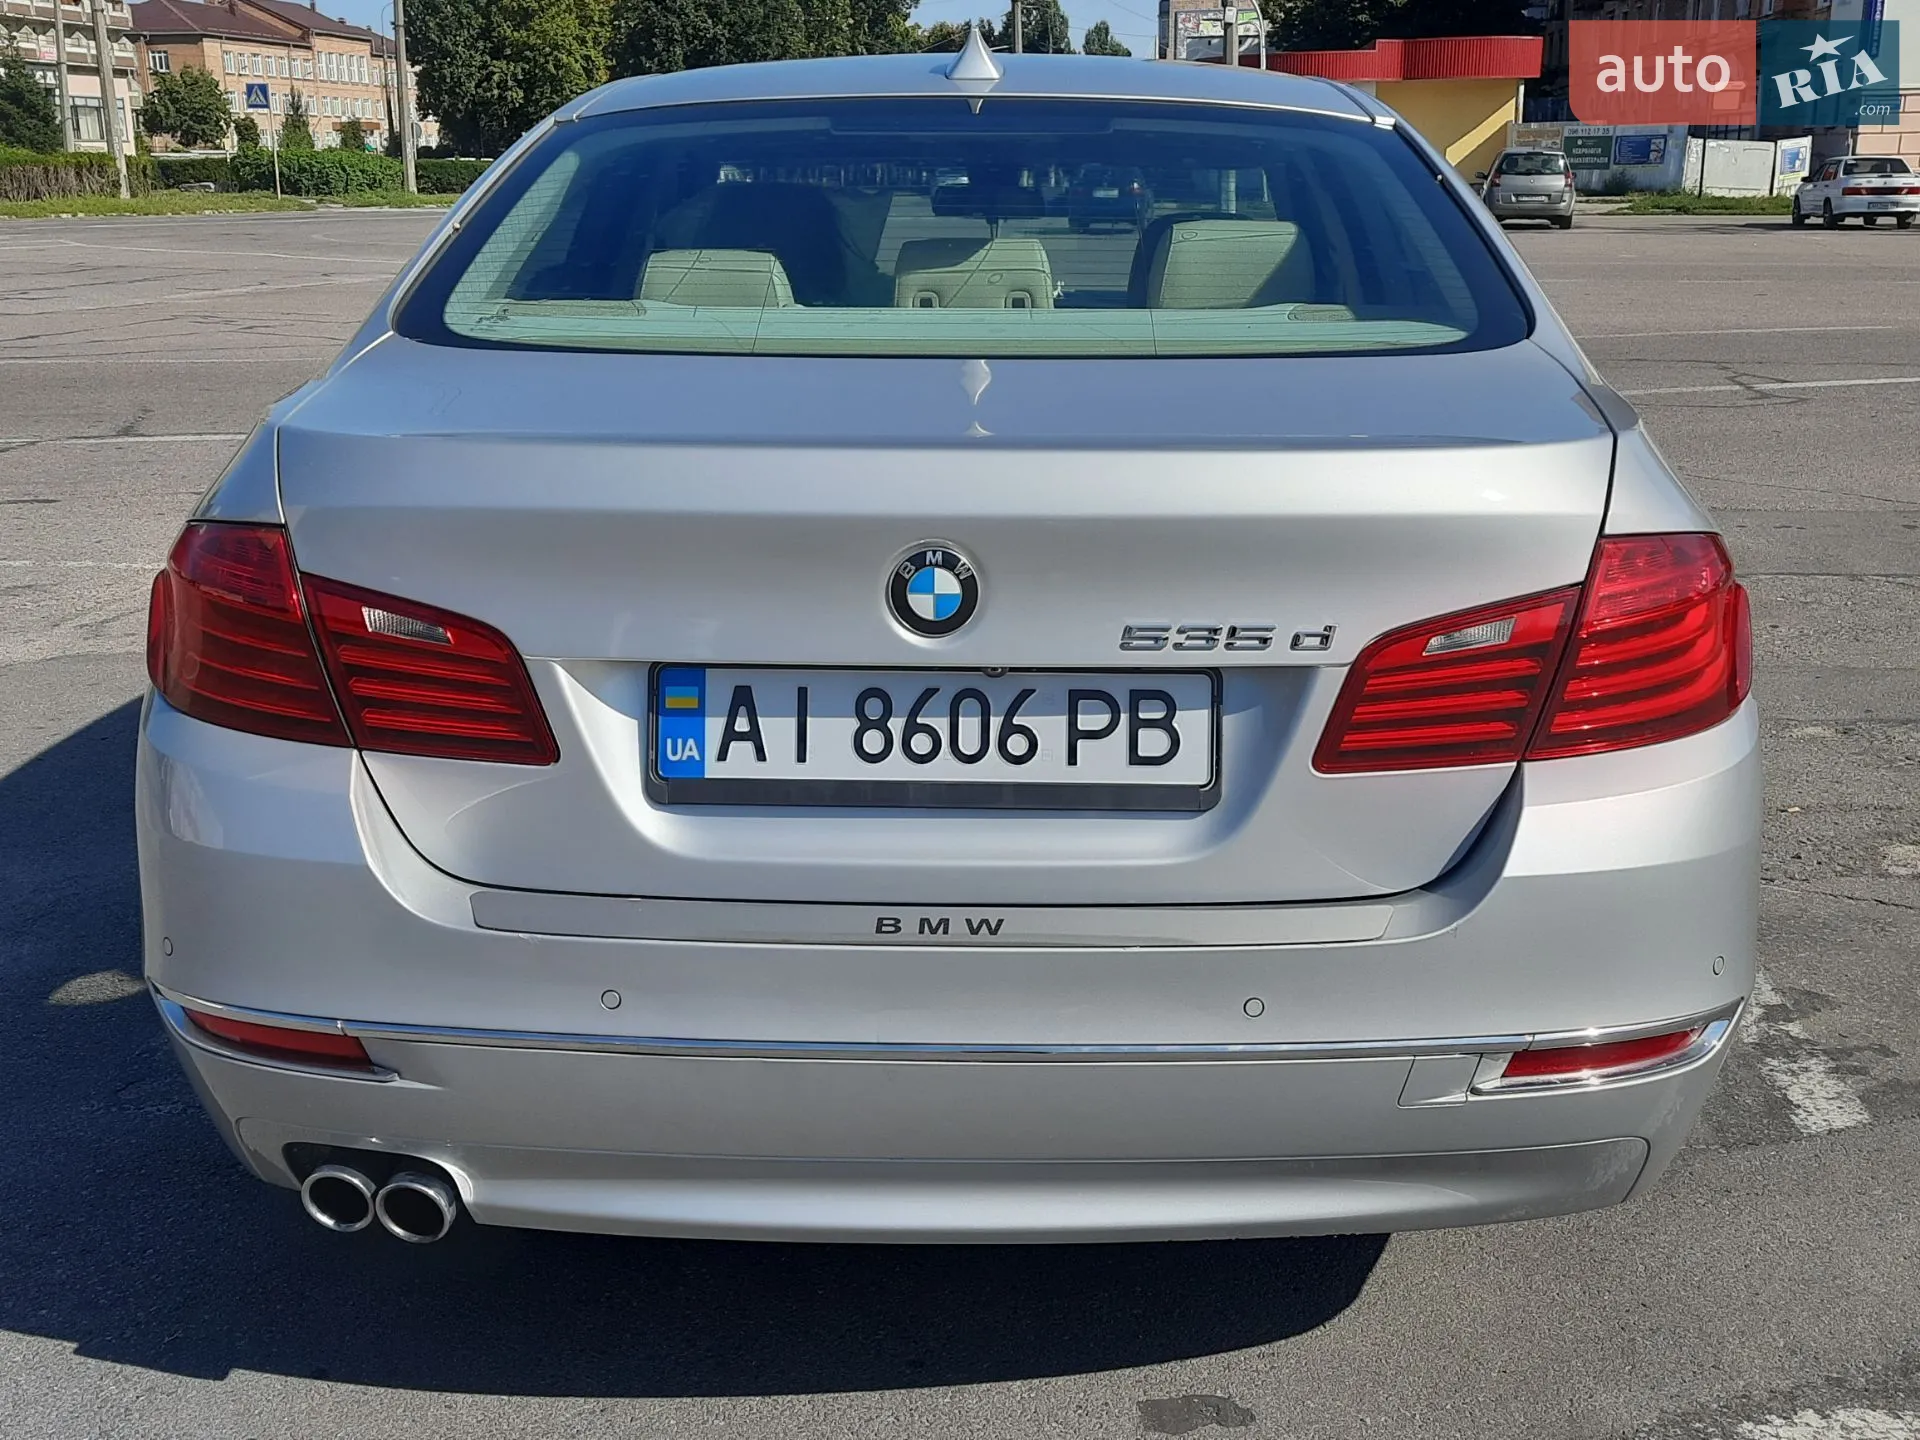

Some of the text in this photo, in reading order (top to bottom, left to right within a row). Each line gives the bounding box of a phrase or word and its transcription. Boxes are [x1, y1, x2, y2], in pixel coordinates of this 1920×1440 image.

[898, 550, 972, 580] BMW
[1119, 624, 1339, 652] 535 d
[716, 686, 1180, 767] AI 8606 PB
[667, 739, 701, 763] UA
[875, 917, 1005, 936] BMW
